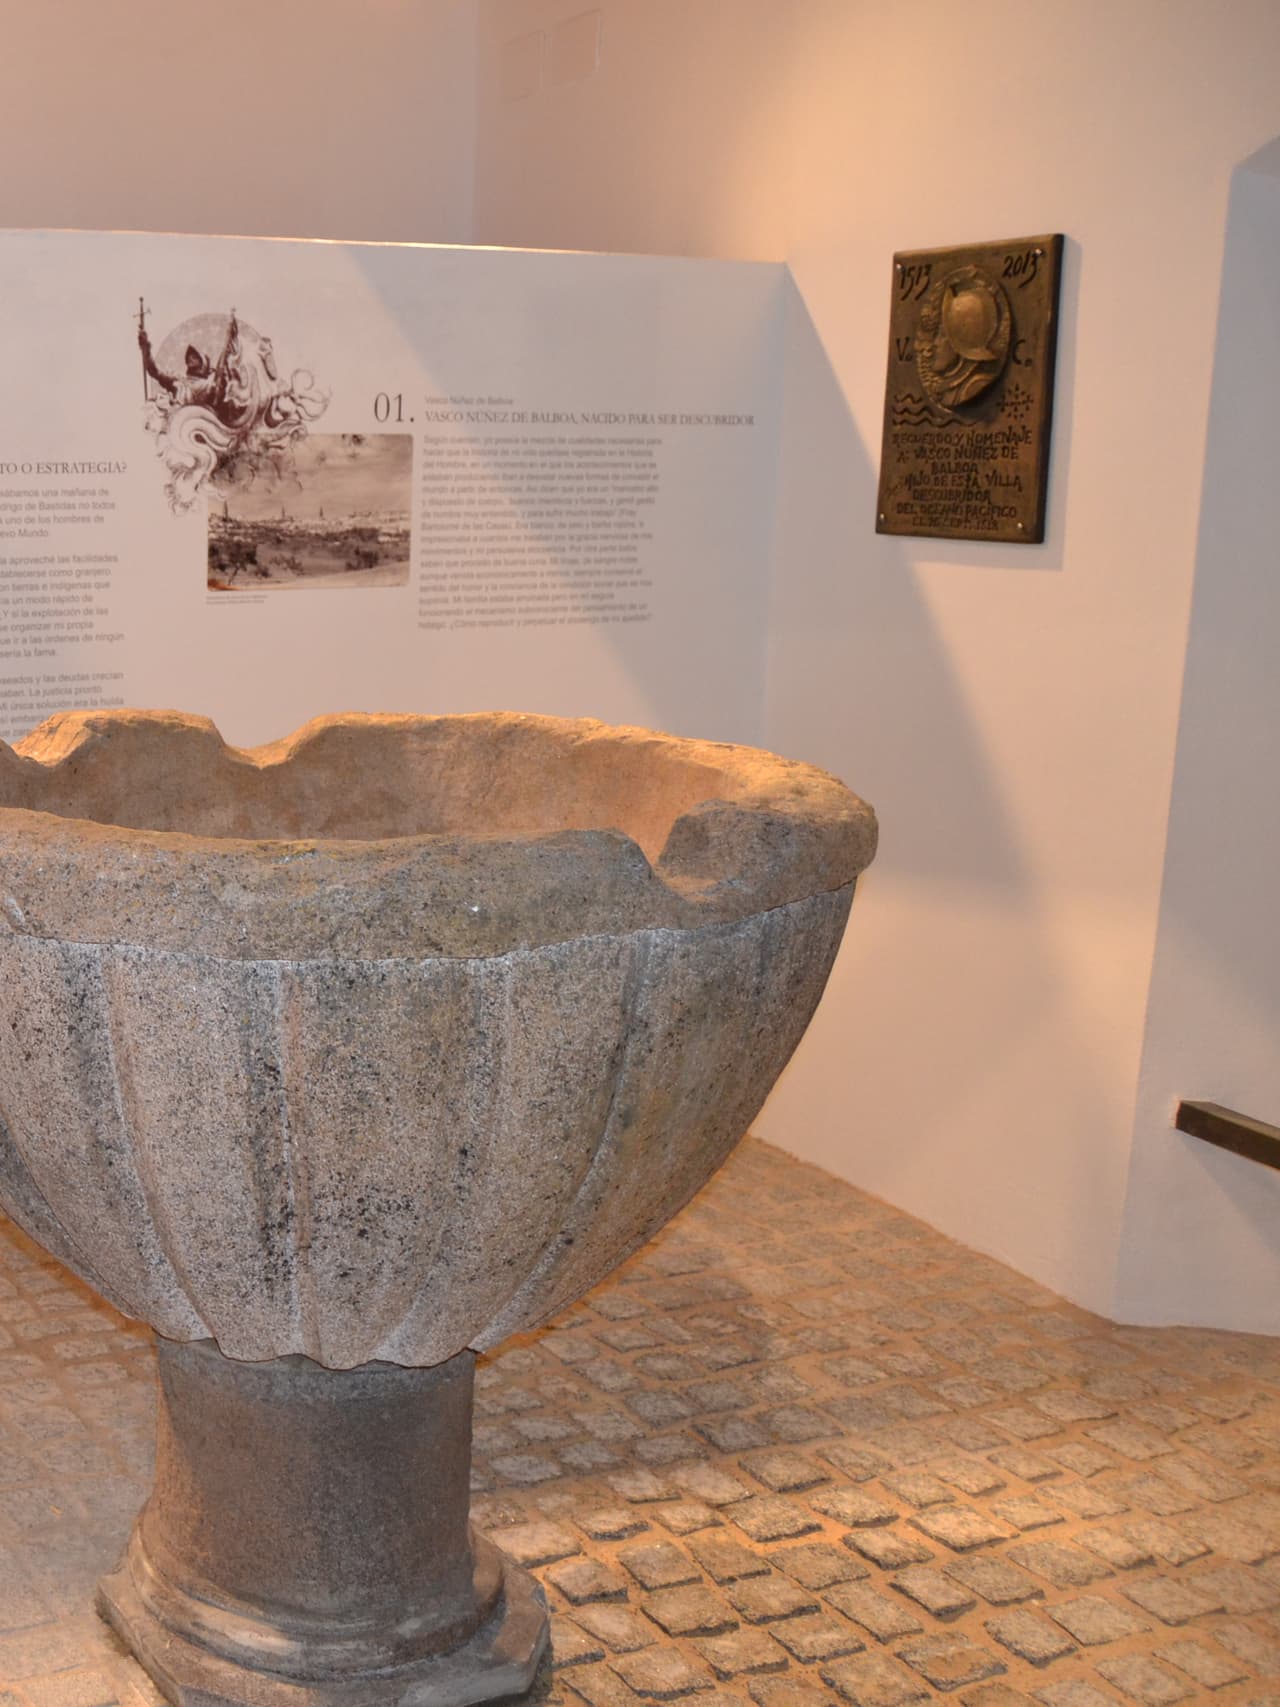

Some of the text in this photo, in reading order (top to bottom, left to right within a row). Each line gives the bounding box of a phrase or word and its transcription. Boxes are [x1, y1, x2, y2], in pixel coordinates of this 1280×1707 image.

[1002, 251, 1039, 288] 2013
[898, 264, 932, 300] 1513
[373, 393, 415, 423] 01.
[424, 410, 464, 423] VASCO
[511, 411, 528, 424] DE
[580, 412, 626, 424] NACIDO
[627, 413, 655, 424] PARA
[657, 413, 677, 424] SER
[679, 414, 754, 425] DESCUBRIDOR
[892, 425, 1032, 447] RECUERDO Y HOMENAJE
[914, 446, 951, 461] VASCO
[1001, 446, 1019, 460] DE
[20, 463, 33, 474] O
[36, 461, 127, 474] ESTRATEGIA?
[931, 461, 978, 475] BALBOA
[905, 469, 1022, 491] HIJO DE ESTA VILLA
[913, 489, 991, 504] DESCUBRIDOR
[896, 502, 917, 514] DEL
